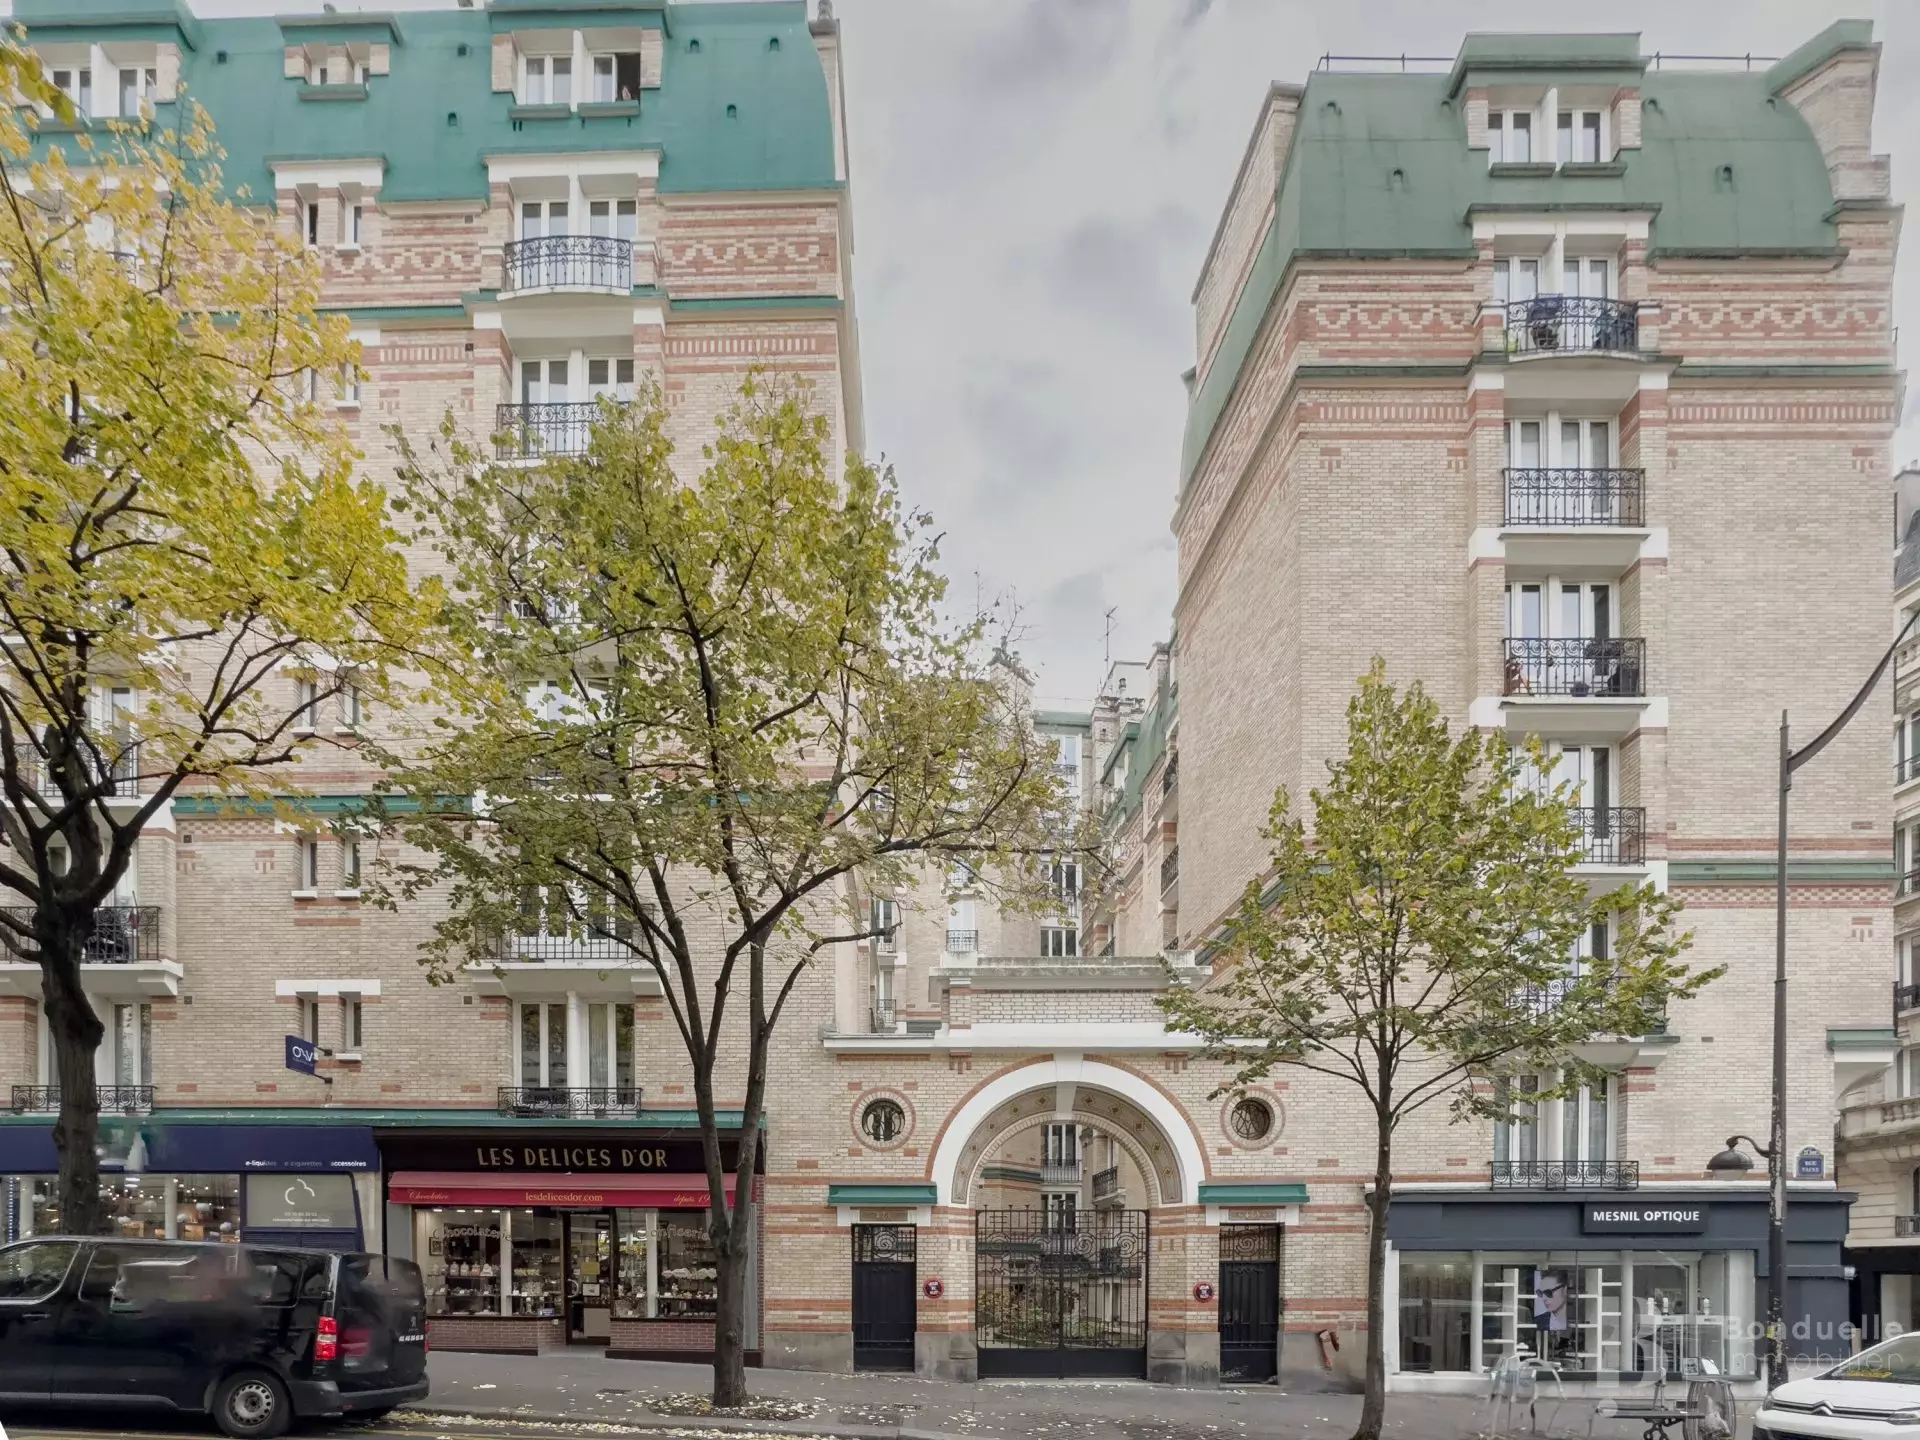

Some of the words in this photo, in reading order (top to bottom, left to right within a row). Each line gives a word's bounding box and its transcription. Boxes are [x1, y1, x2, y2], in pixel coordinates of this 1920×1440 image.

[477, 1148, 515, 1166] LES
[524, 1148, 611, 1167] DELICES
[622, 1149, 668, 1168] D'OR
[330, 1160, 367, 1168] accessoires
[525, 1192, 603, 1203] lesdelicesdor.com
[1593, 1211, 1640, 1222] MESNIL
[1643, 1211, 1700, 1222] OPTIQUE
[432, 1223, 512, 1241] Chocolaterie
